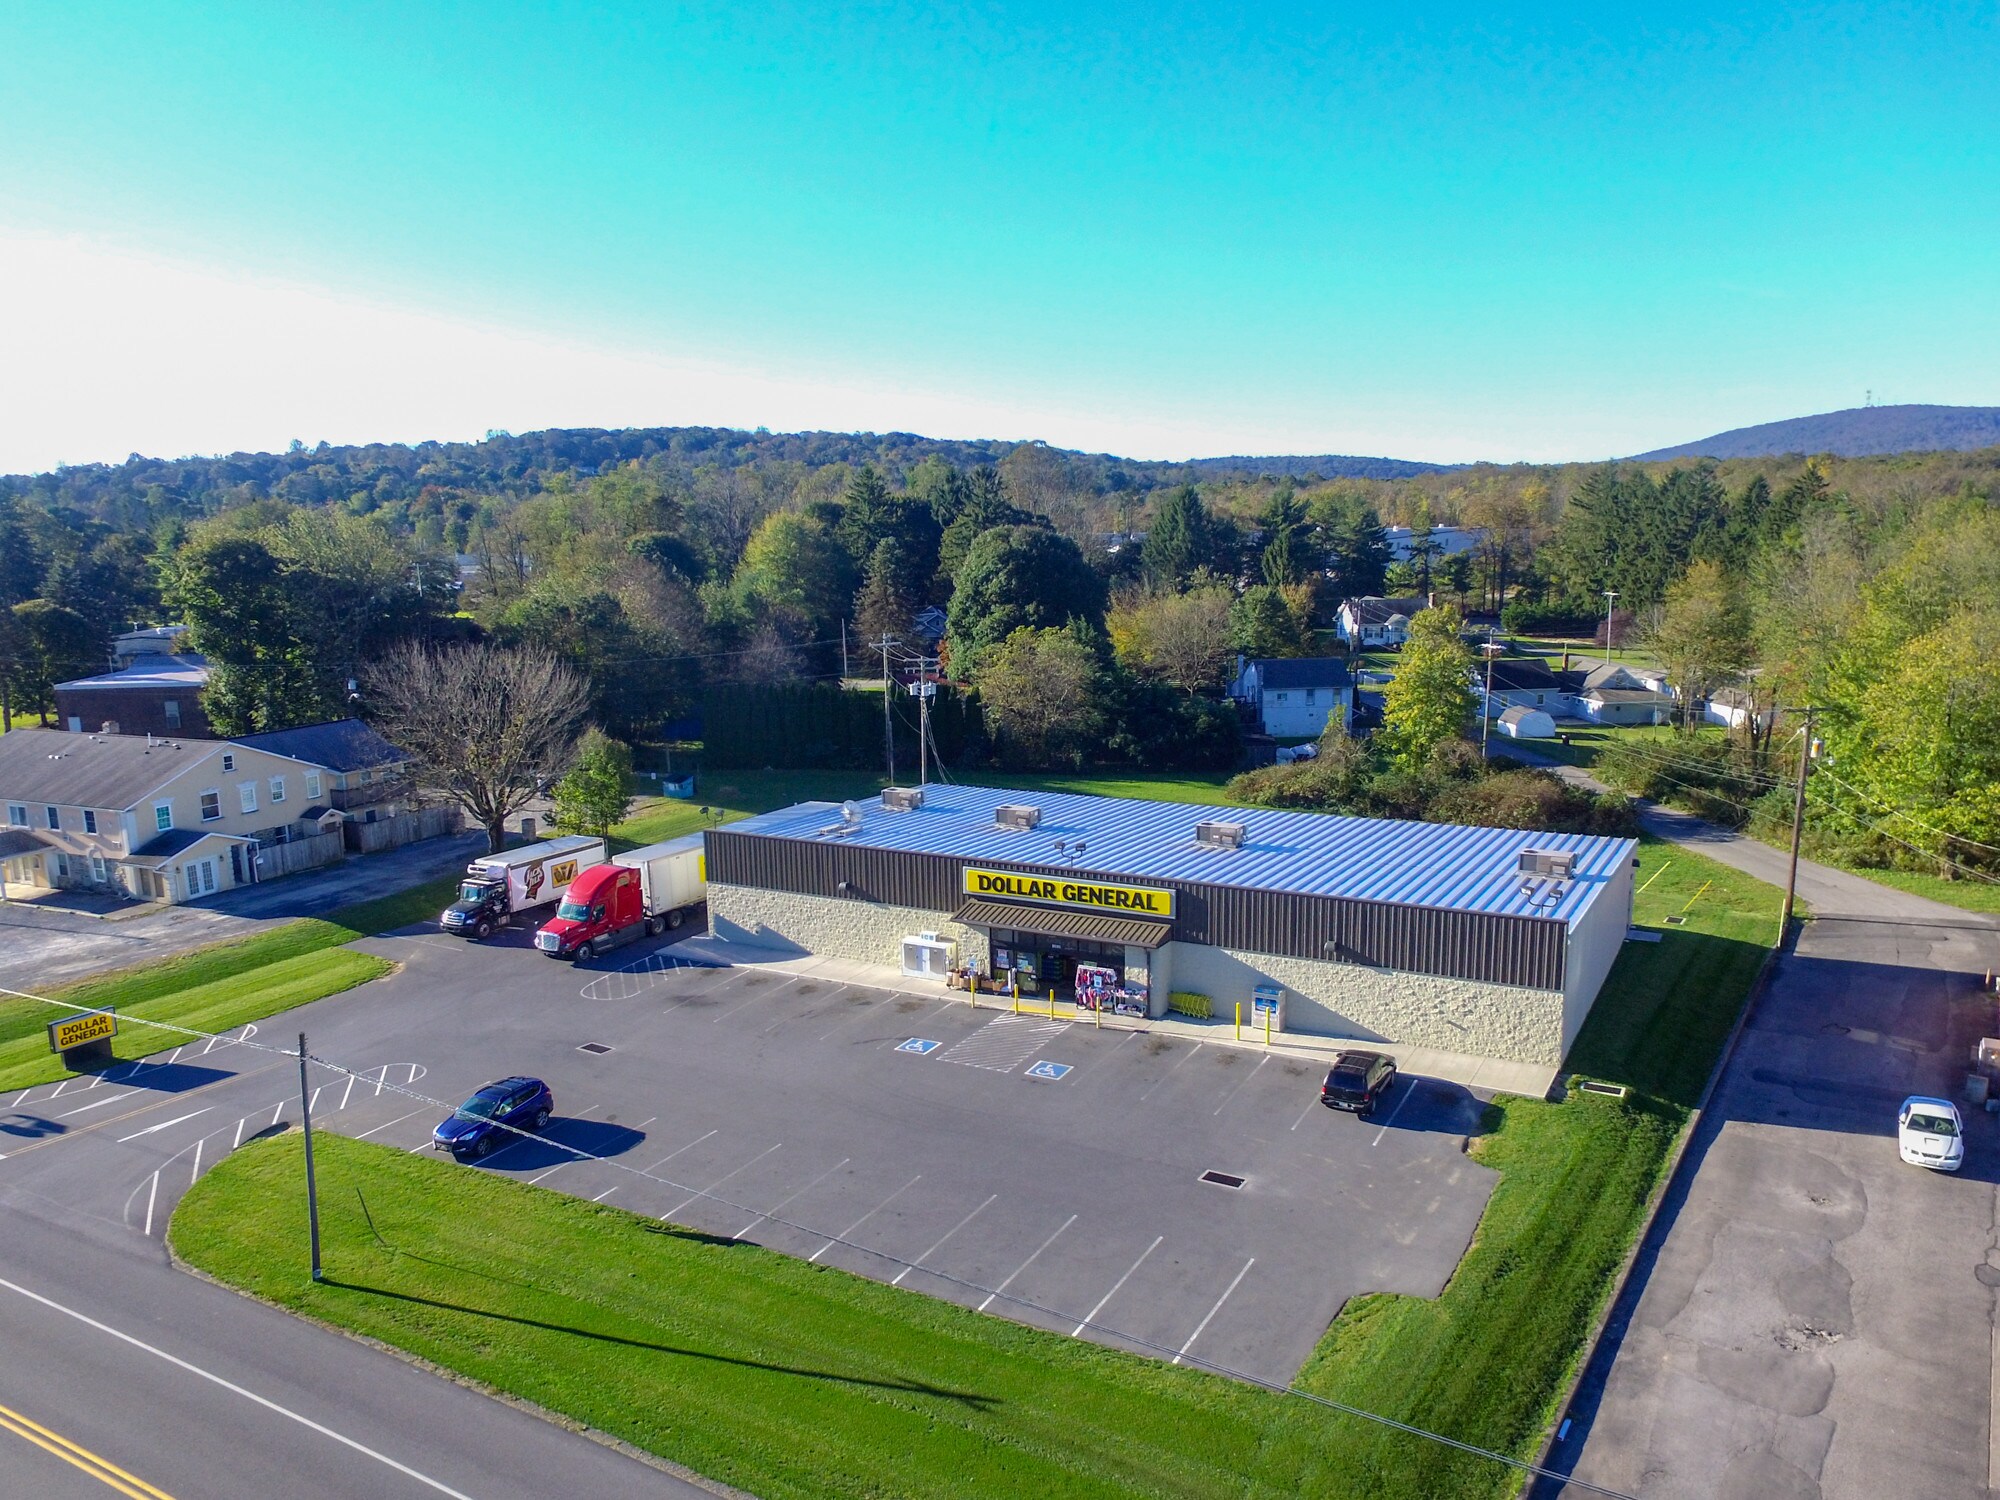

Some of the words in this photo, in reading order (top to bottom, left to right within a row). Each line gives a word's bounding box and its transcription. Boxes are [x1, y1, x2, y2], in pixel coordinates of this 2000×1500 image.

[977, 874, 1057, 899] DOLLAR
[1062, 884, 1158, 911] GENERAL
[60, 1025, 111, 1046] GENERAL
[62, 1016, 107, 1036] DOLLAR
